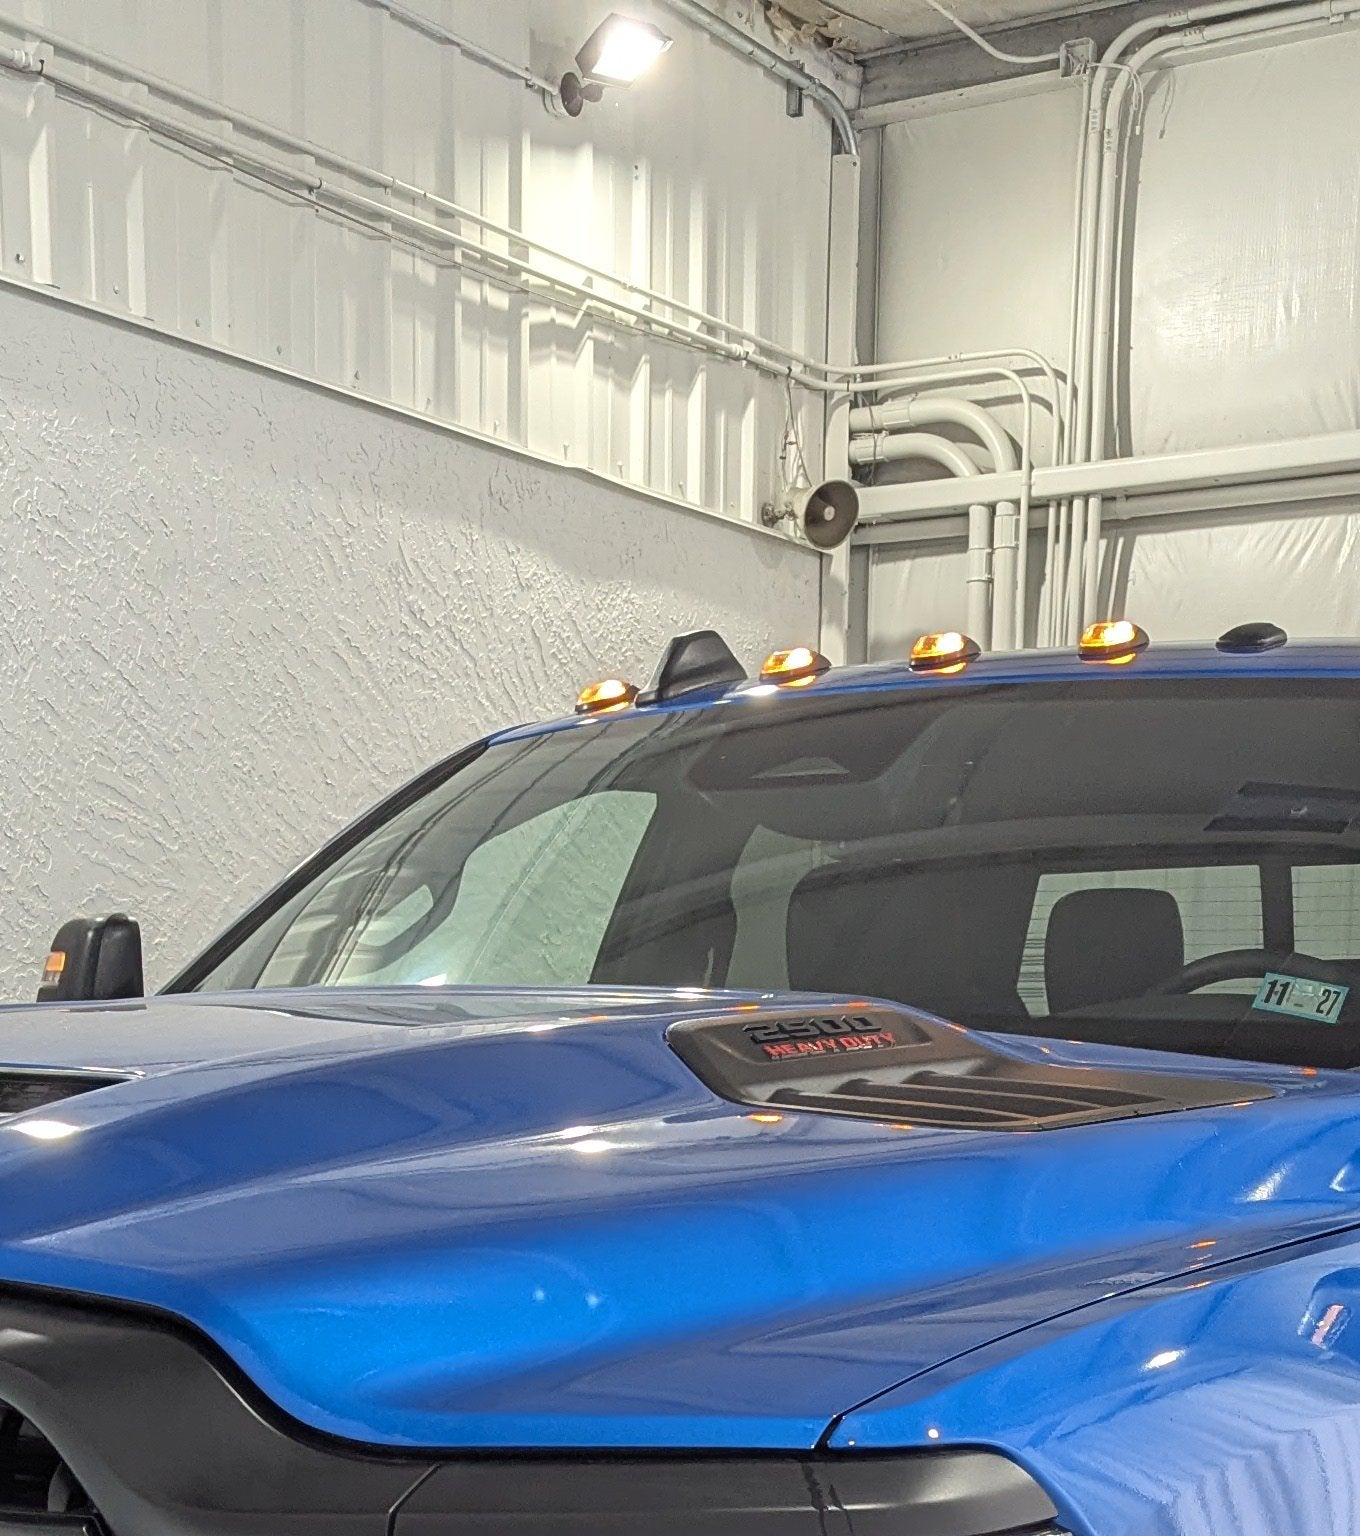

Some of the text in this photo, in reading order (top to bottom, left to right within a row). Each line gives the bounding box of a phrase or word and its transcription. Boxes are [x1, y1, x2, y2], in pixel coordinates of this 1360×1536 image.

[1315, 988, 1342, 1017] 27
[763, 1031, 896, 1061] HEAVY DUTY
